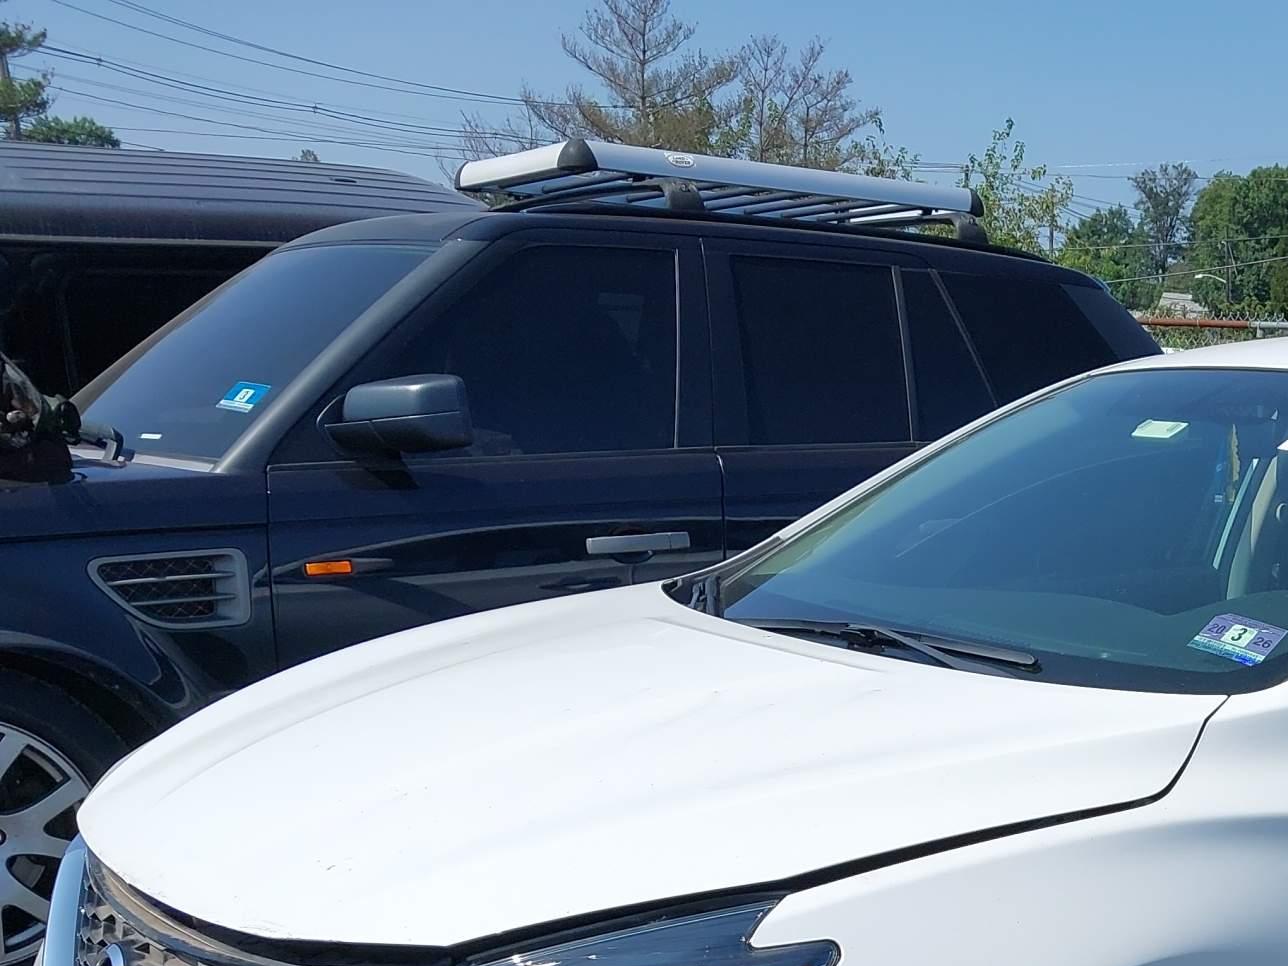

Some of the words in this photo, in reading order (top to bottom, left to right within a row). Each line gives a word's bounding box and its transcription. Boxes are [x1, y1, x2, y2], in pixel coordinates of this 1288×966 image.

[1207, 623, 1226, 634] 20
[1230, 627, 1248, 642] 3
[1253, 637, 1273, 649] 26
